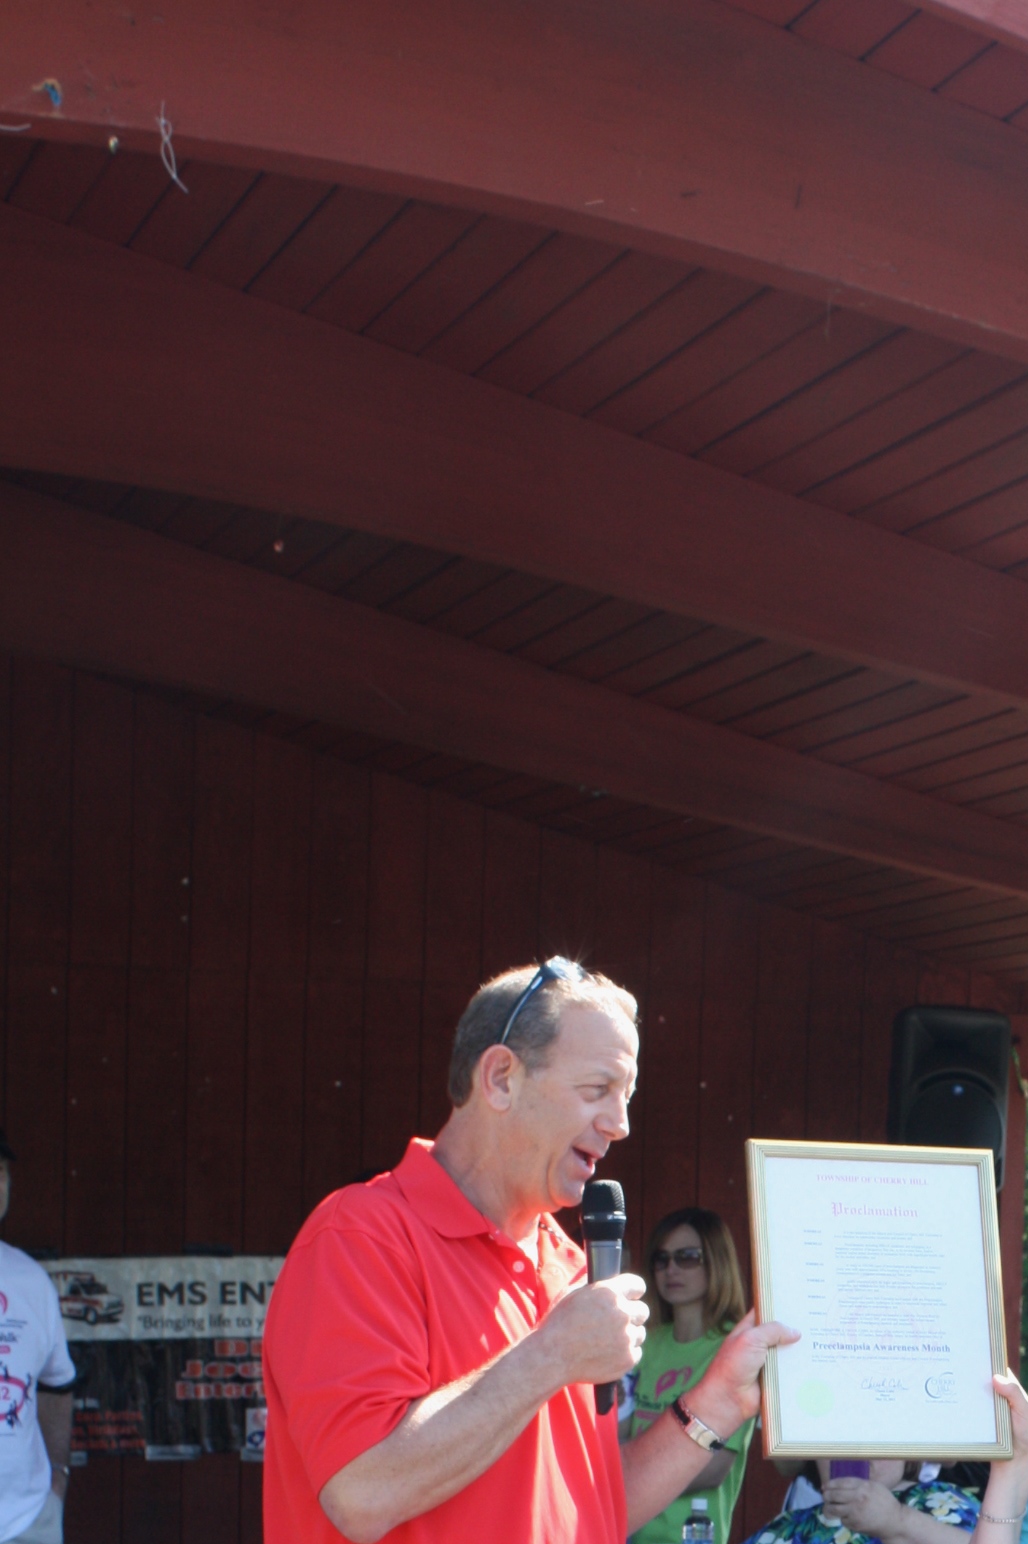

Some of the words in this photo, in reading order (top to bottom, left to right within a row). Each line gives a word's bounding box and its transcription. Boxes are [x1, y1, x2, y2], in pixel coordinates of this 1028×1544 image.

[816, 1173, 859, 1183] TOWNSHIP
[874, 1176, 907, 1185] CHERRY
[909, 1177, 929, 1186] HILL
[831, 1201, 919, 1218] Proclamation
[136, 1280, 208, 1307] EMS
[219, 1280, 271, 1306] EN
[812, 1341, 871, 1353] Preeclampsia
[873, 1342, 920, 1352] Awareness
[921, 1343, 951, 1353] Month
